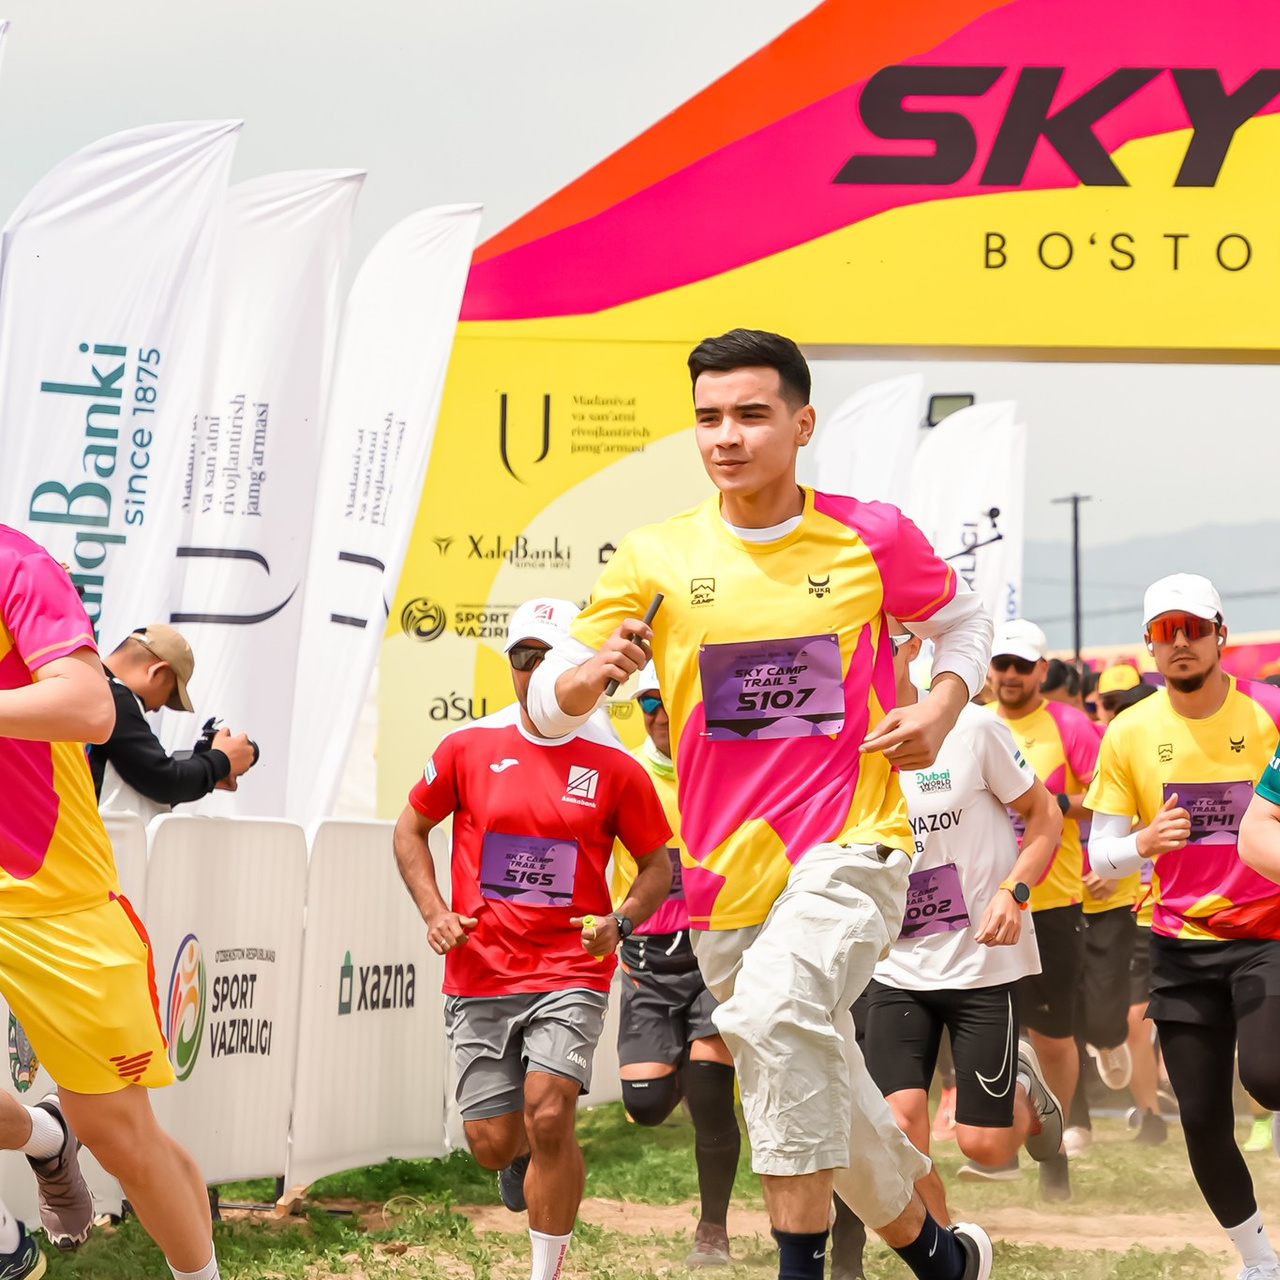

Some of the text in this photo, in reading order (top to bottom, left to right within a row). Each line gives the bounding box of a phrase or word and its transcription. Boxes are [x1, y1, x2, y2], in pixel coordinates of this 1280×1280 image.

[125, 347, 160, 526] since 1875
[468, 534, 571, 562] XalqBanki
[455, 612, 509, 624] SPORT
[735, 665, 808, 678] SKY CAMP
[744, 677, 783, 688] TRAIL
[735, 688, 816, 712] 5107
[915, 769, 951, 784] Dubai
[504, 853, 554, 864] SKY CAMP
[510, 861, 537, 869] TRAIL
[502, 870, 557, 886] 5165
[212, 974, 257, 1013] SPORT
[357, 963, 416, 1011] xazna
[210, 1018, 272, 1058] VAZIRLIGI
[566, 1051, 587, 1069] JAKO
